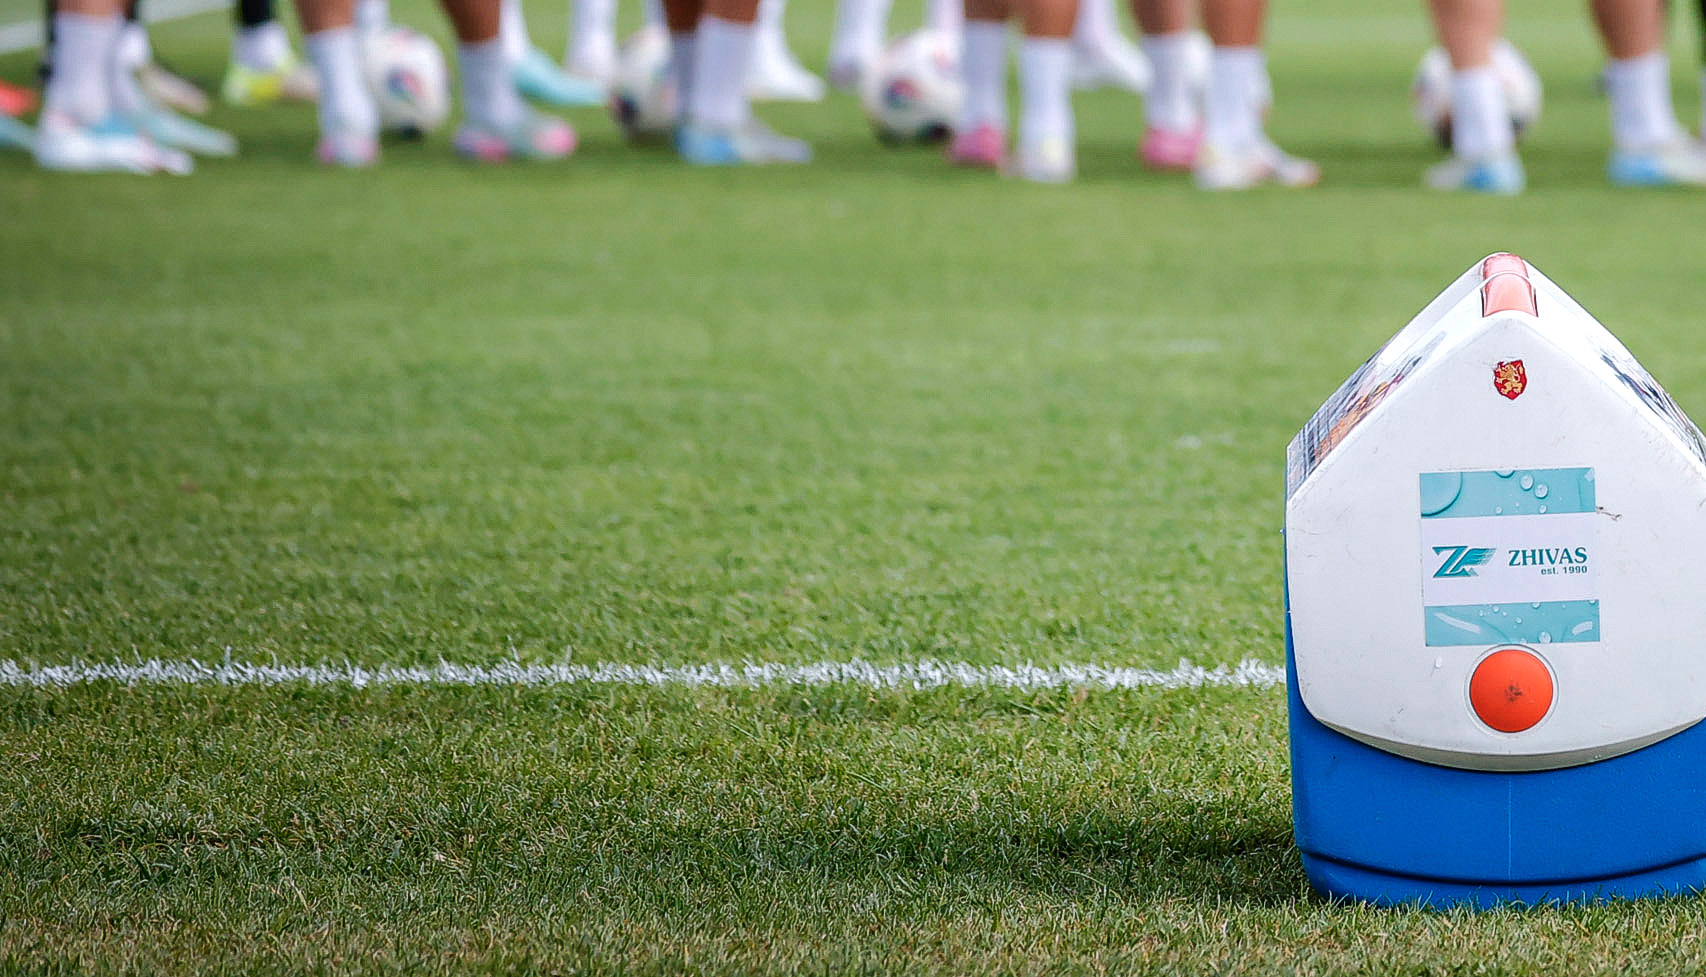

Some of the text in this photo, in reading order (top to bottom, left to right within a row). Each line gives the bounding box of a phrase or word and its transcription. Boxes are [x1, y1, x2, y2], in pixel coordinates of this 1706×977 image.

[1508, 547, 1588, 567] ZHIVAS
[1541, 565, 1588, 575] est. 1990
